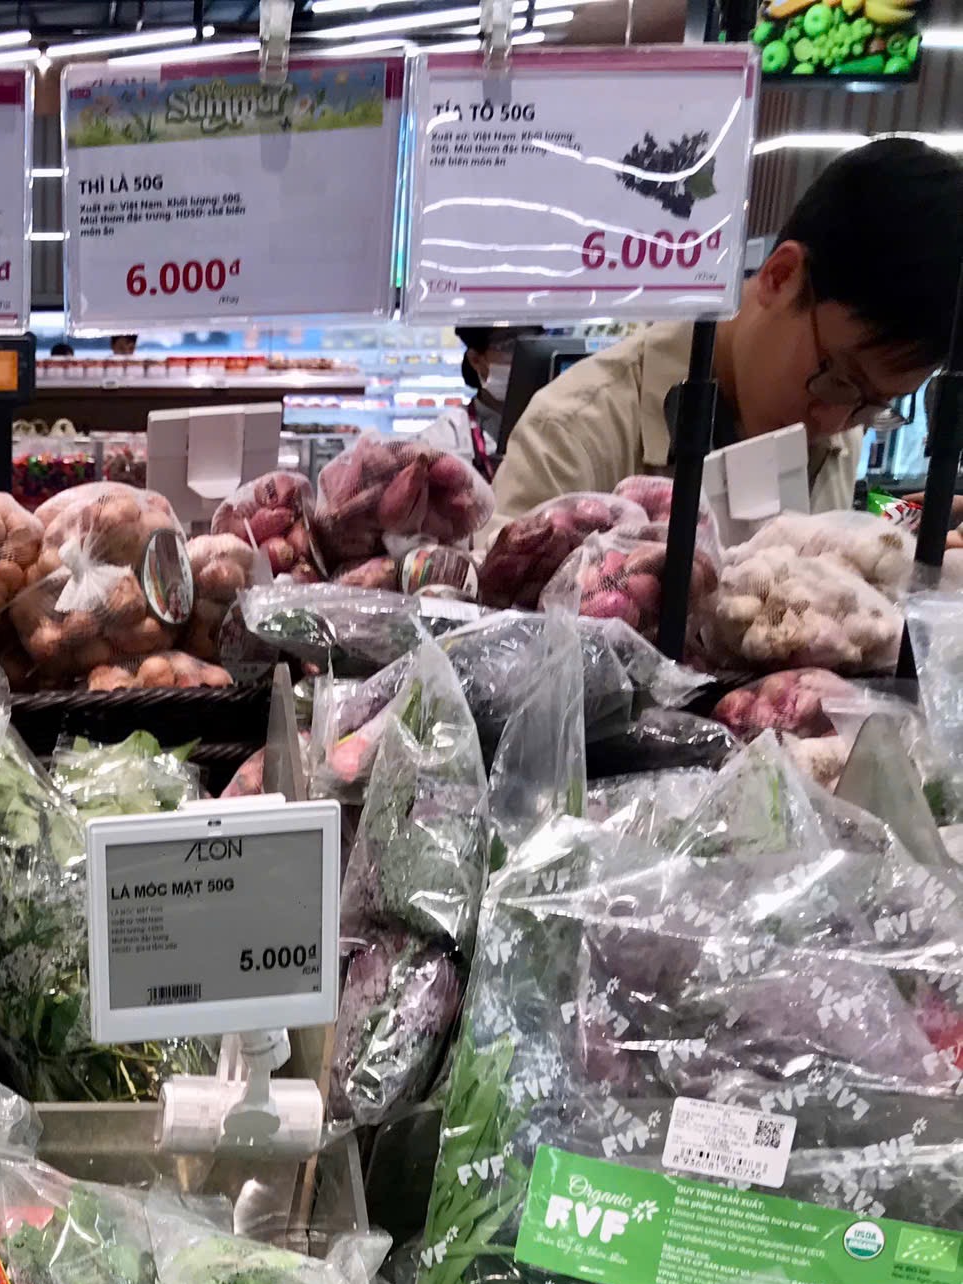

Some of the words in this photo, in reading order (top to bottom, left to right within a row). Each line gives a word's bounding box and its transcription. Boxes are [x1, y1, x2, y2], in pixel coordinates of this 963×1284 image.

[469, 99, 494, 121] TÔ
[500, 103, 535, 121] 50G
[79, 174, 105, 195] THÌ
[110, 172, 129, 193] LÀ
[134, 174, 164, 192] 50G
[111, 883, 130, 900] LÁ
[207, 878, 235, 892] 50G
[568, 1174, 632, 1208] Organic
